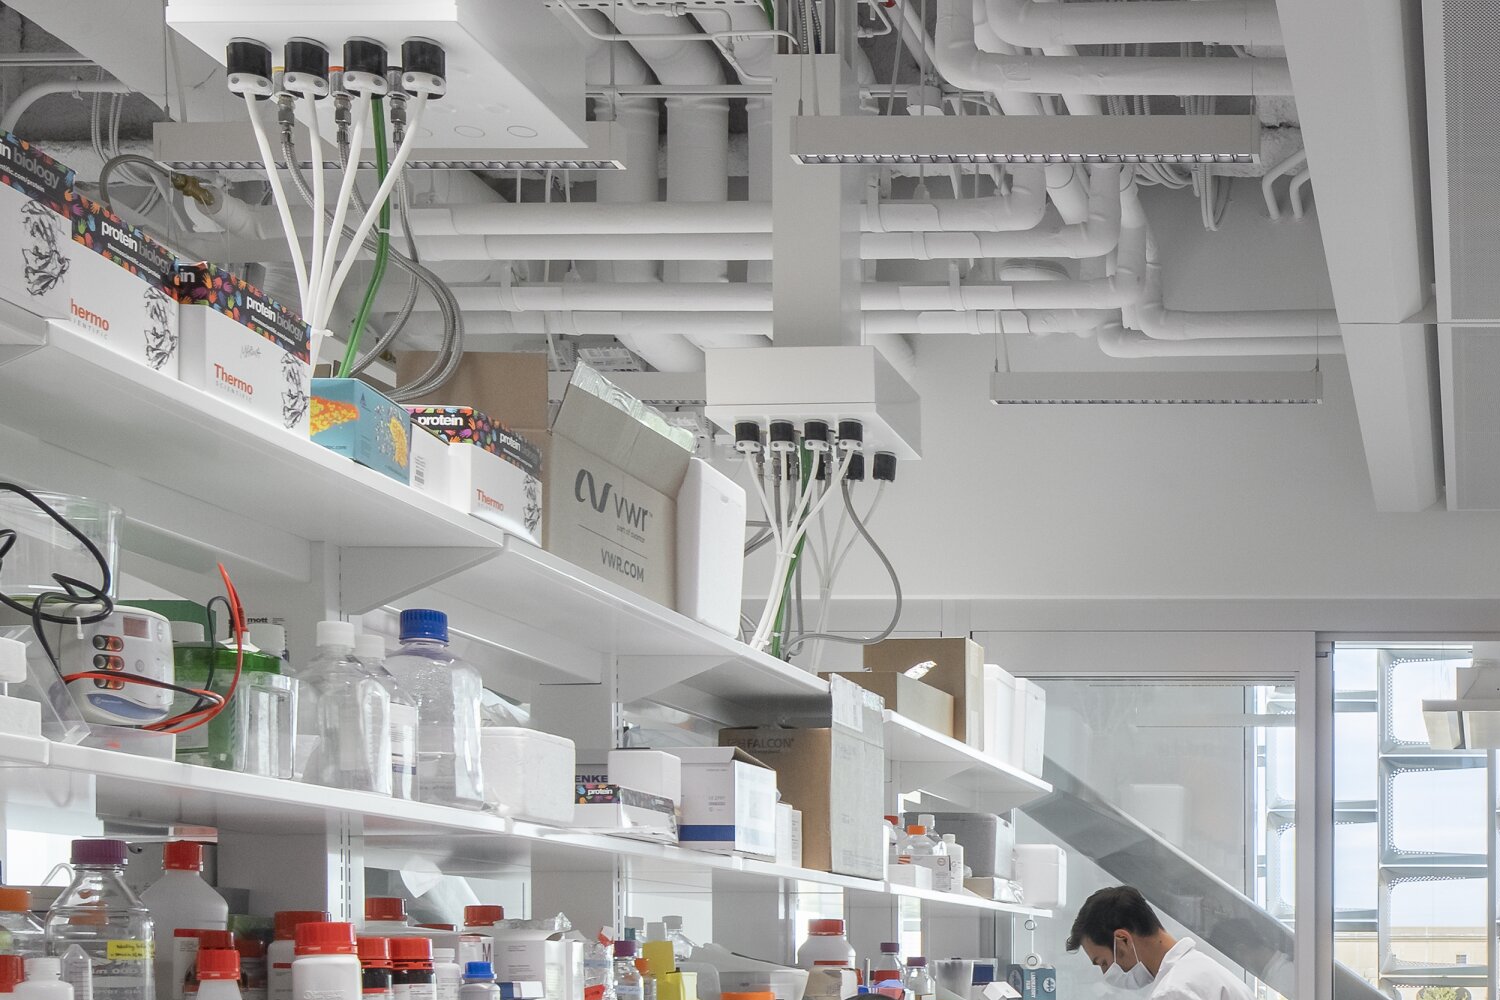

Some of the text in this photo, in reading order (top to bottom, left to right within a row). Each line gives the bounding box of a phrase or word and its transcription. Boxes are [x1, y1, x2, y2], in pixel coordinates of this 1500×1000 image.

[13, 149, 60, 190] biology
[101, 220, 171, 274] protein biology
[70, 297, 110, 331] hermo
[246, 295, 304, 341] protein biology
[214, 363, 254, 395] Thermo
[417, 413, 464, 427] protein
[500, 432, 521, 452] protein
[476, 489, 504, 512] Thermo
[601, 548, 645, 583] VWR.COM
[748, 739, 792, 749] FALCON
[587, 788, 614, 797] protein
